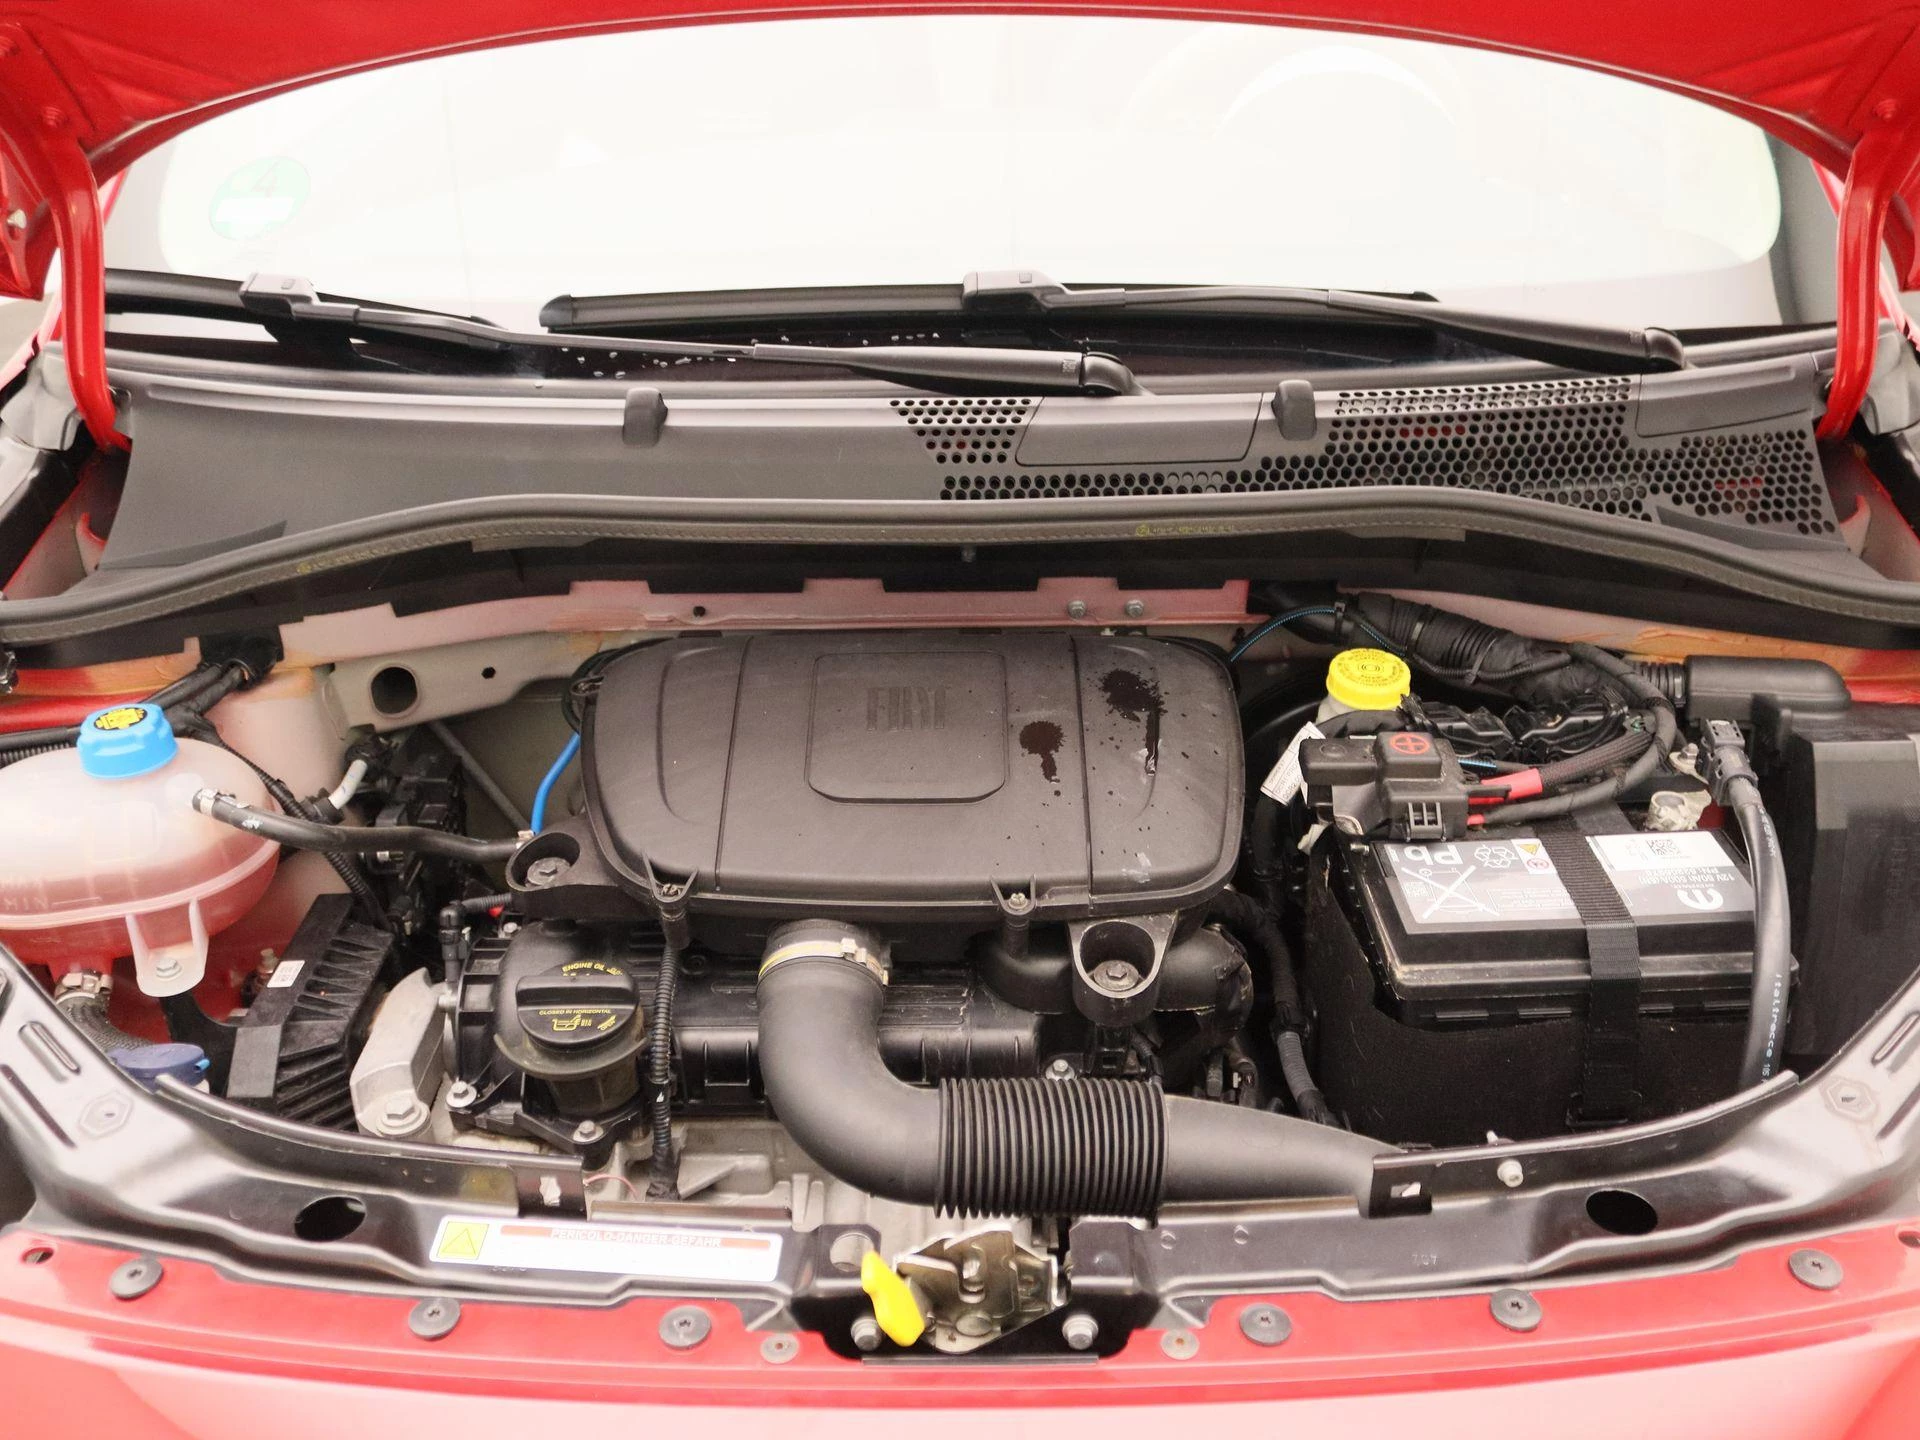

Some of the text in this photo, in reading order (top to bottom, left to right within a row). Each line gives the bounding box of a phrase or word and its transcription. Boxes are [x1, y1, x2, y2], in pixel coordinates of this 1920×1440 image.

[1404, 845, 1464, 866] Pb
[562, 961, 605, 972] ENGINE OIL
